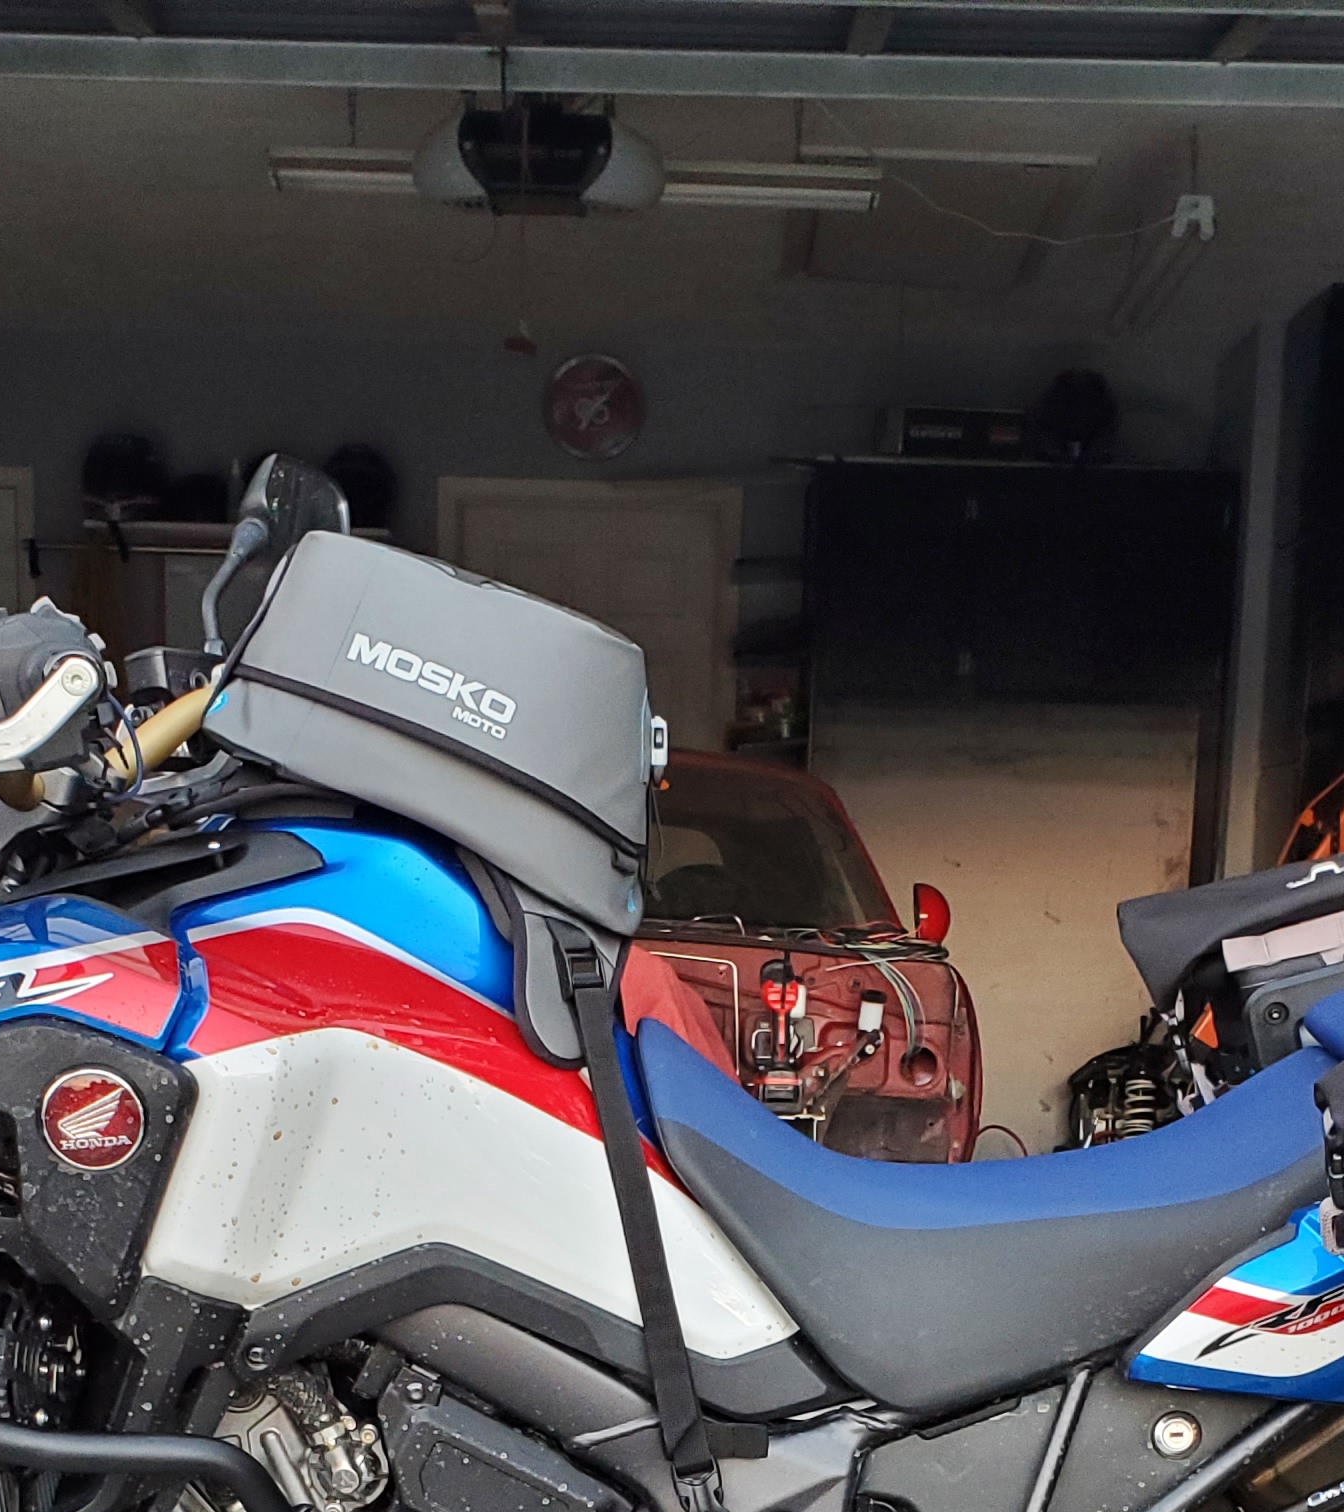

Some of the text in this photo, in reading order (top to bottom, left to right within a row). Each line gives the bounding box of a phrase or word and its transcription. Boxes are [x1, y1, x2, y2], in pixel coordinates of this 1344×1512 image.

[346, 632, 517, 724] MOSKO
[451, 706, 507, 740] MOTO
[59, 1135, 133, 1151] HONDA
